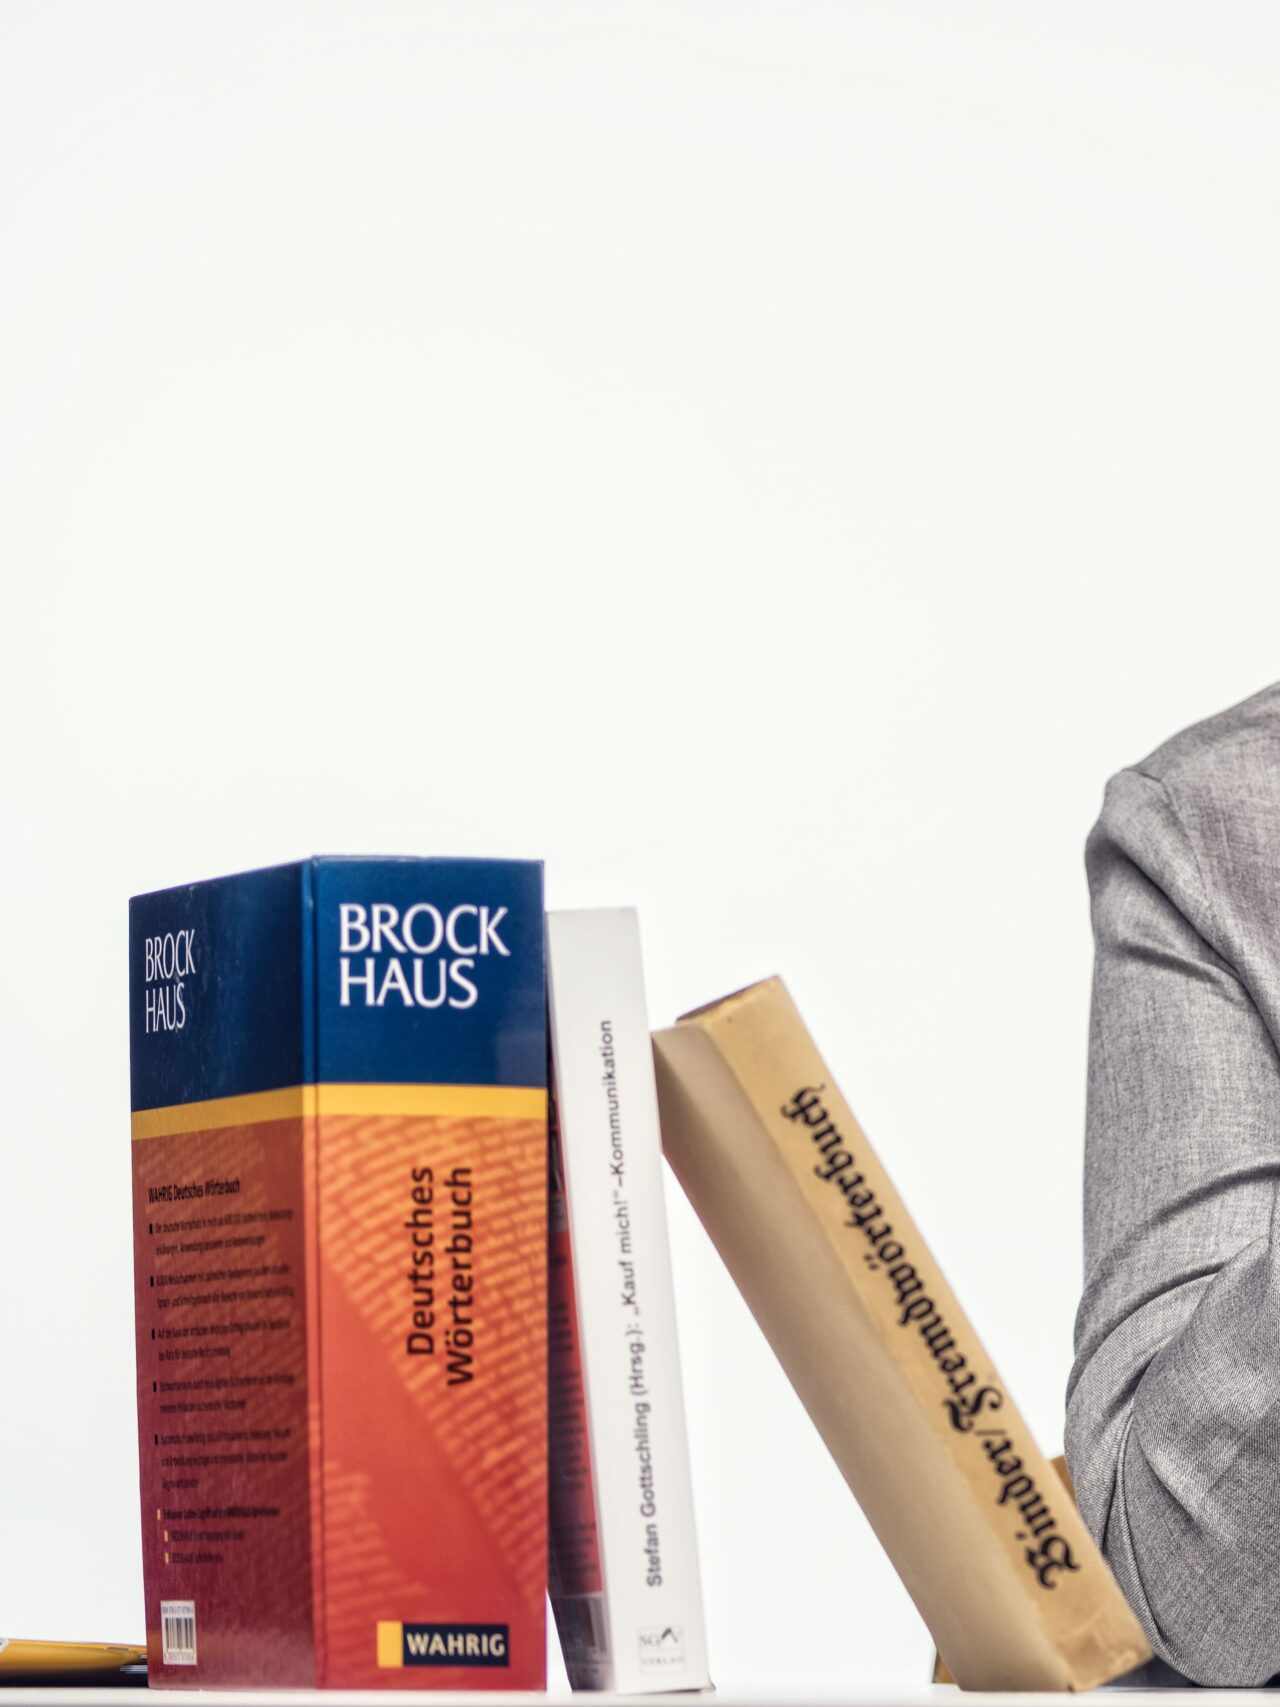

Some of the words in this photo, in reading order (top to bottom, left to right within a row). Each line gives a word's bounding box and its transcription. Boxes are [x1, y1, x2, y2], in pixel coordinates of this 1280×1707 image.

[144, 929, 197, 983] BROCK
[338, 903, 511, 957] BROCK
[144, 981, 187, 1034] HAUS
[339, 957, 479, 1010] HAUS
[148, 1184, 173, 1204] WAHRIG
[173, 1181, 204, 1201] Deutsches
[204, 1177, 241, 1198] Wörterbuch
[404, 1166, 435, 1355] Deutsches
[443, 1167, 474, 1387] Wörterbuch
[633, 1401, 656, 1518] Gottschling
[643, 1523, 662, 1587] Stefan
[406, 1632, 506, 1658] WAHRIG
